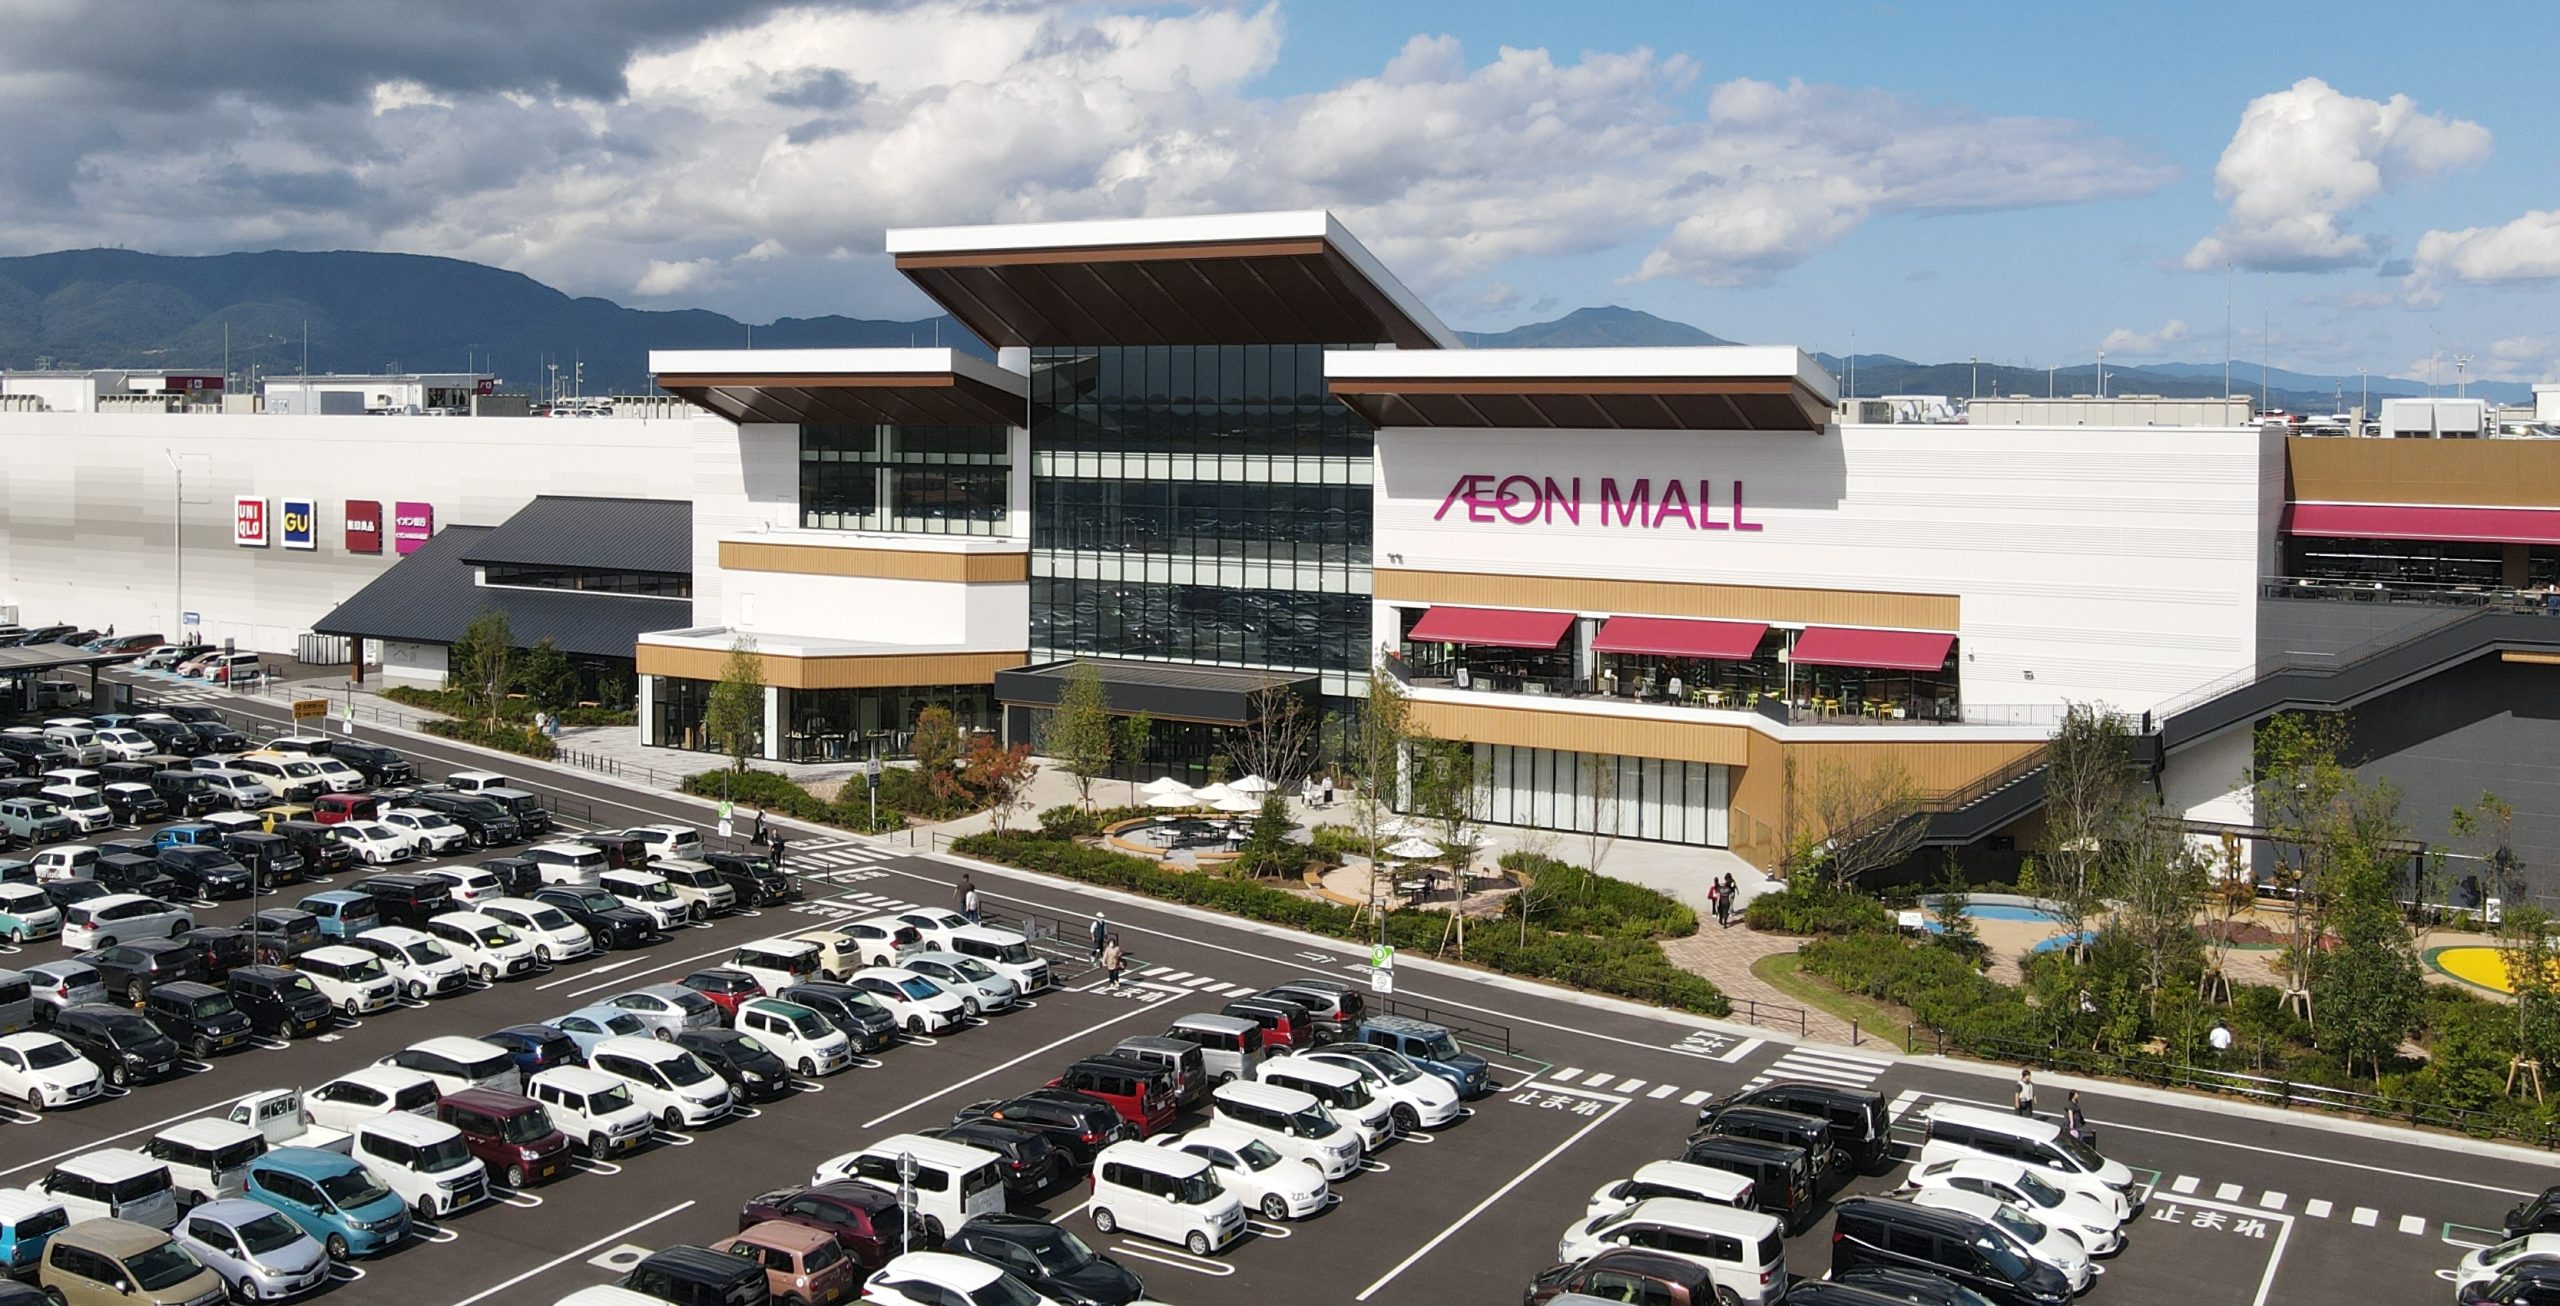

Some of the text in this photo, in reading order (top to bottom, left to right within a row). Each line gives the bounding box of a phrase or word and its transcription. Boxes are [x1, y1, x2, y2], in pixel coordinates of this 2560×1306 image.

[239, 504, 258, 520] UNI
[1600, 478, 1763, 531] MALL
[239, 520, 260, 537] QLO
[285, 512, 308, 532] GU
[1508, 1090, 1602, 1116] 止まれ
[2150, 1204, 2266, 1238] 止まれ
